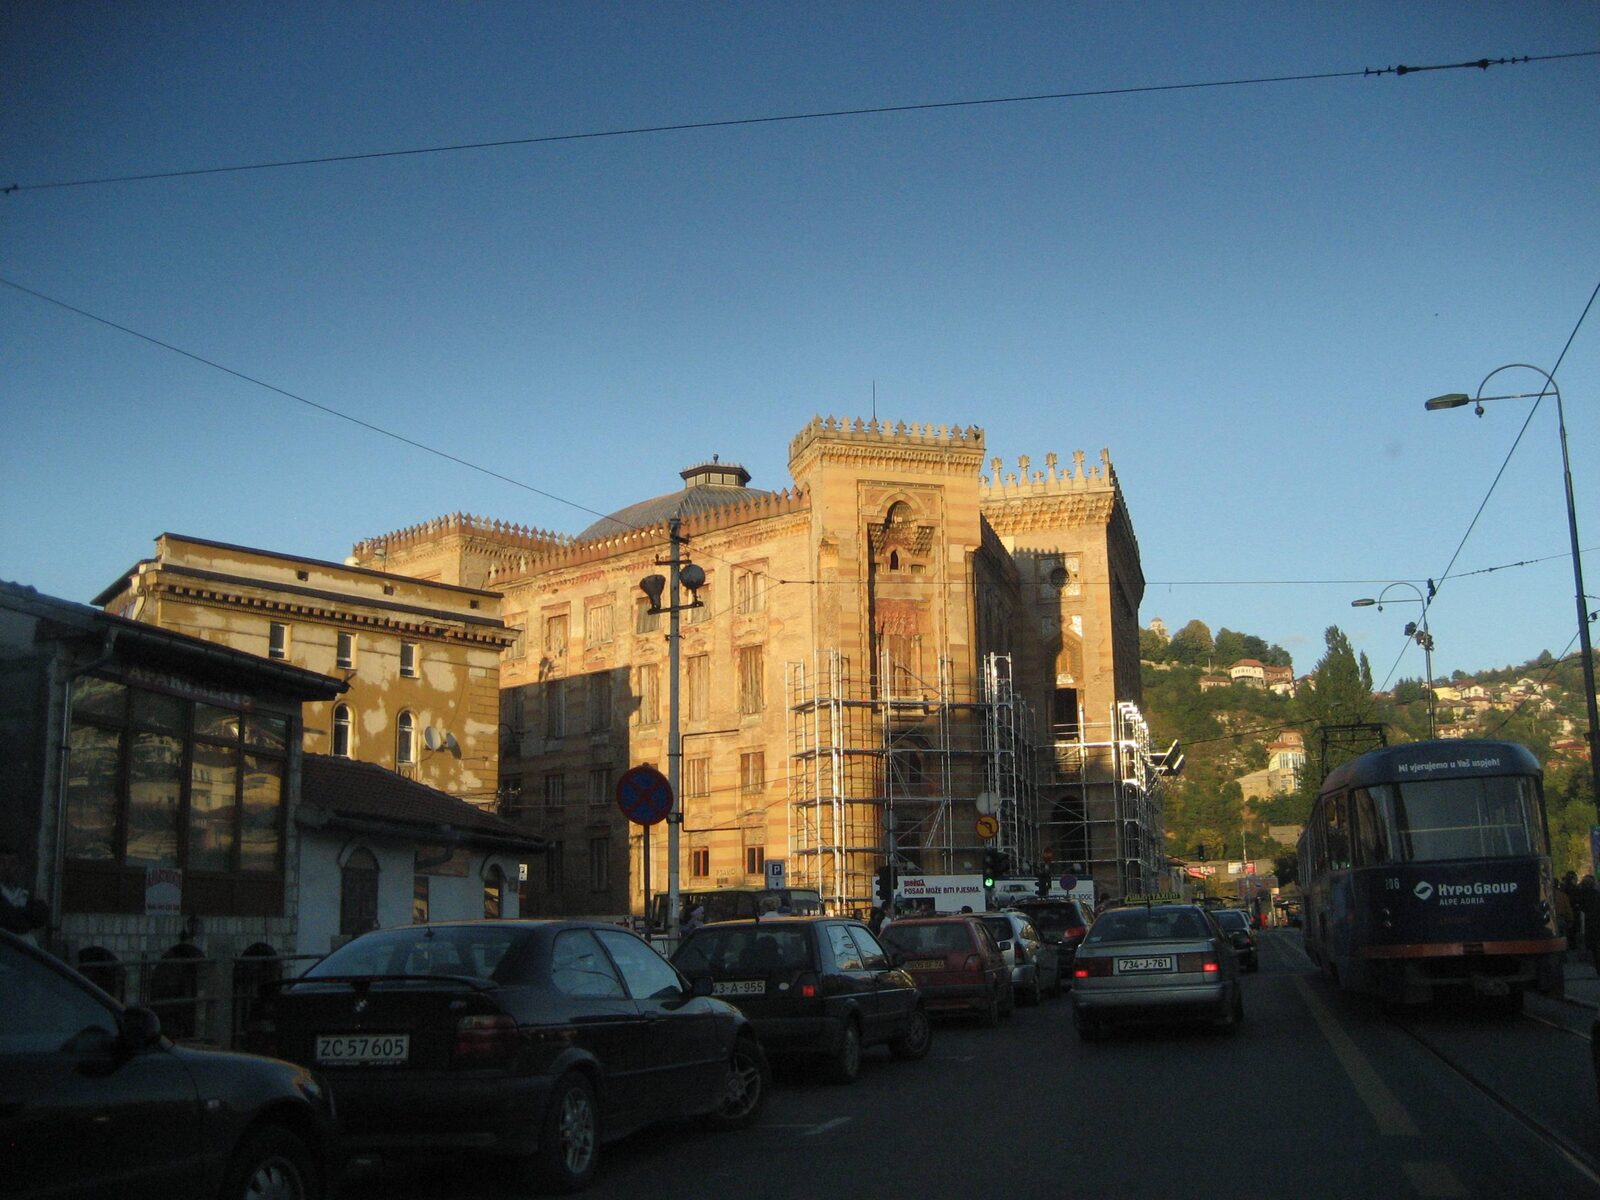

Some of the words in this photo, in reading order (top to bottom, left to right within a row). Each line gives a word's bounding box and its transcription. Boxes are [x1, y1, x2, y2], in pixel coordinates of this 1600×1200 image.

[1409, 761, 1448, 773] vjerujemo
[925, 886, 941, 894] MOŽE
[1439, 898, 1458, 906] ALPE
[1460, 897, 1485, 905] ADRIA
[1123, 959, 1167, 969] 734-J-761
